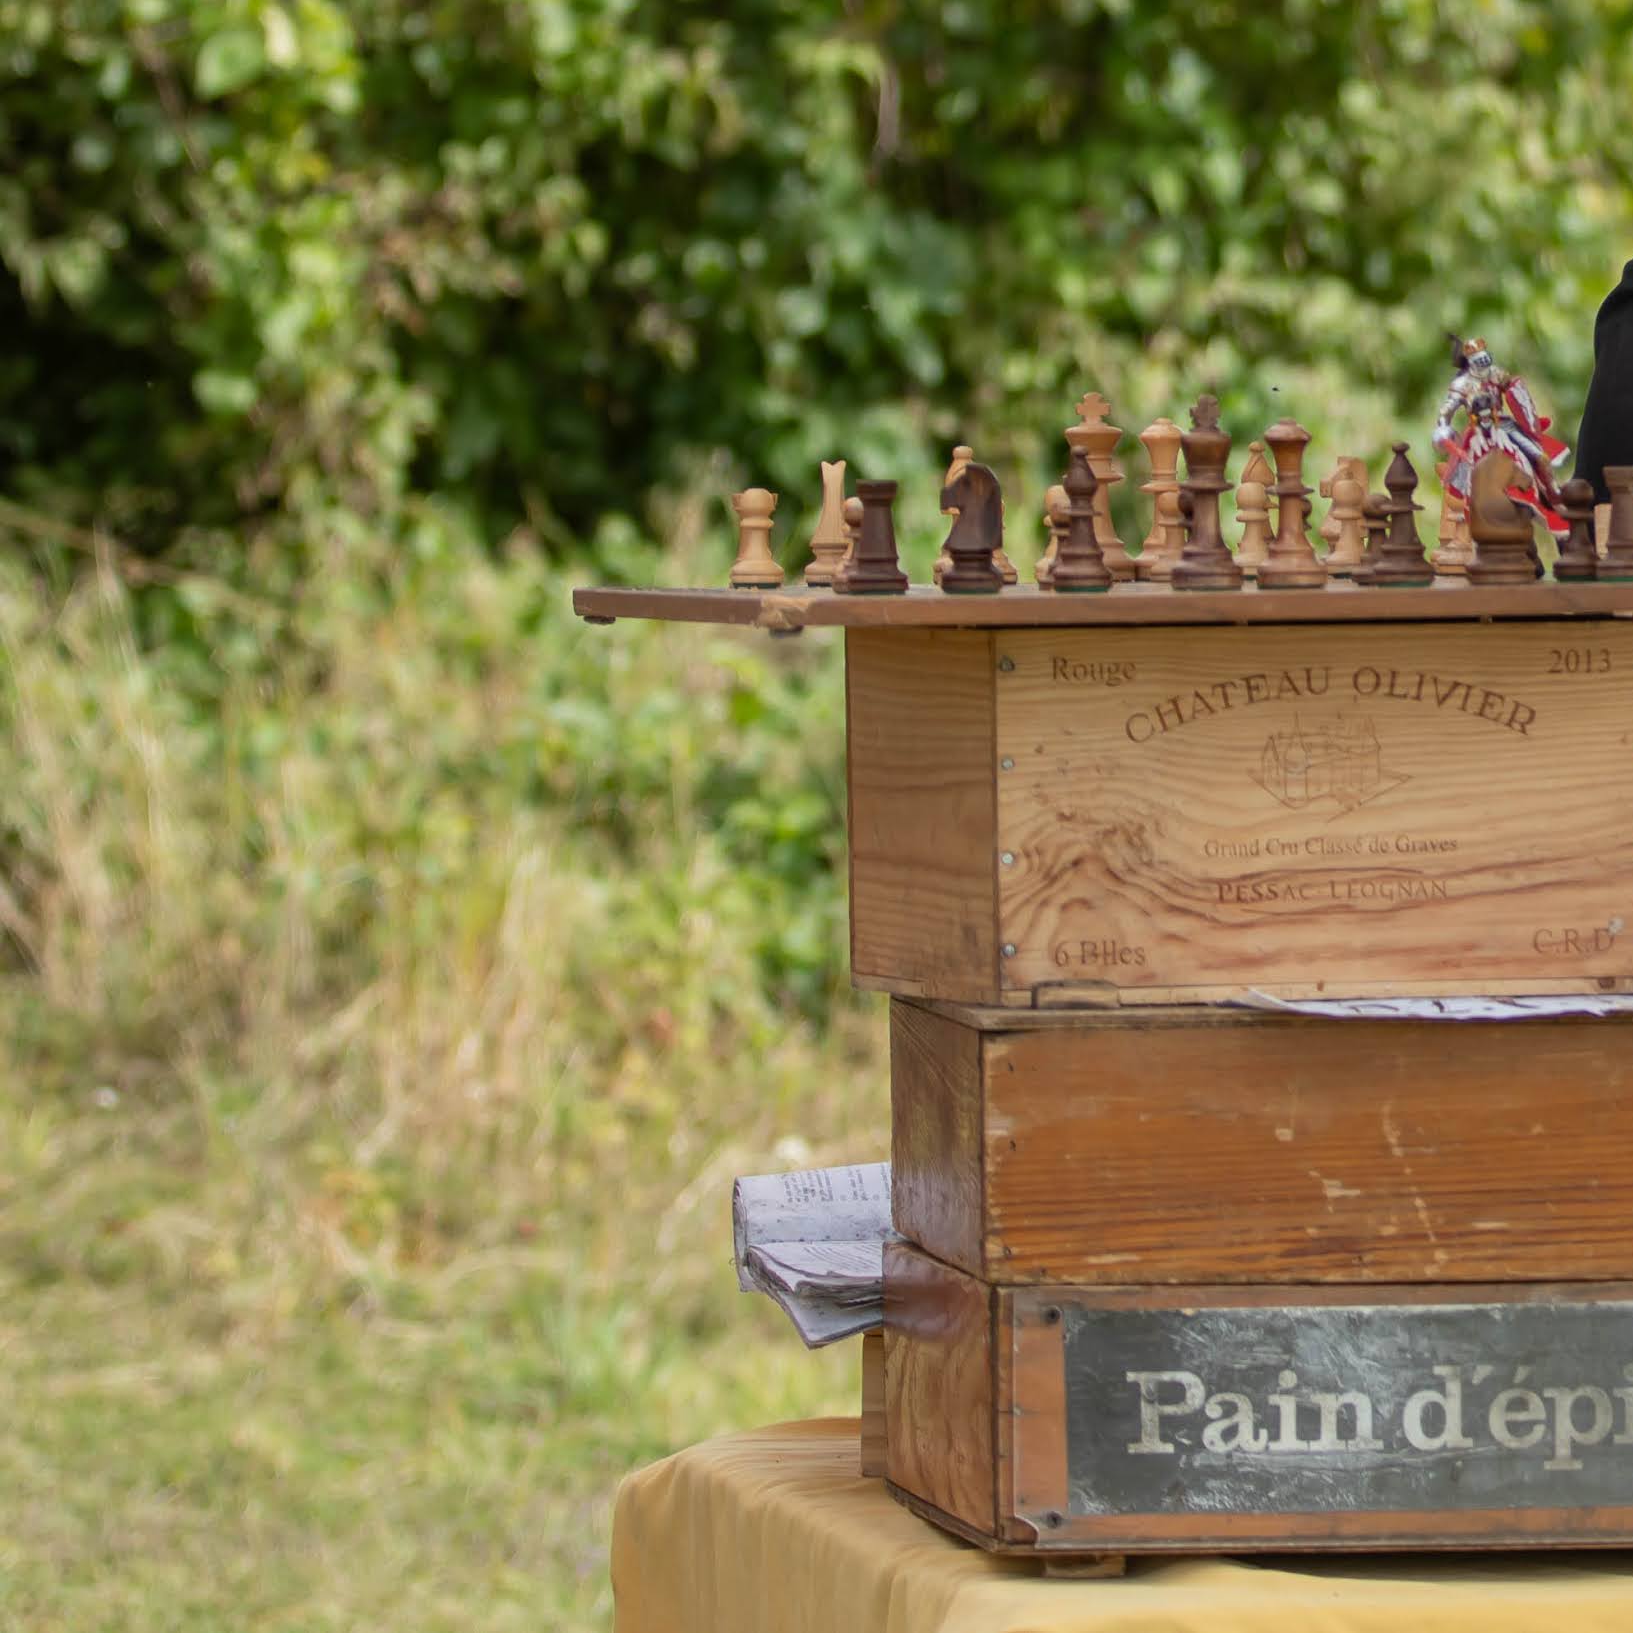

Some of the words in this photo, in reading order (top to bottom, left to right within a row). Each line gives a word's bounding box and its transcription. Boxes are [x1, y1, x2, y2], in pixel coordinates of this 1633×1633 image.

[1050, 655, 1137, 686] Rouge
[1546, 648, 1611, 674] 2013
[1124, 666, 1331, 743] CHATEAU
[1352, 666, 1537, 736] OLIVIER
[1204, 838, 1260, 858] Grand
[1265, 838, 1299, 857] Cru
[1368, 836, 1392, 854] de
[1395, 834, 1459, 854] Graves
[1055, 941, 1069, 967] 6
[1124, 1369, 1384, 1455] Pain
